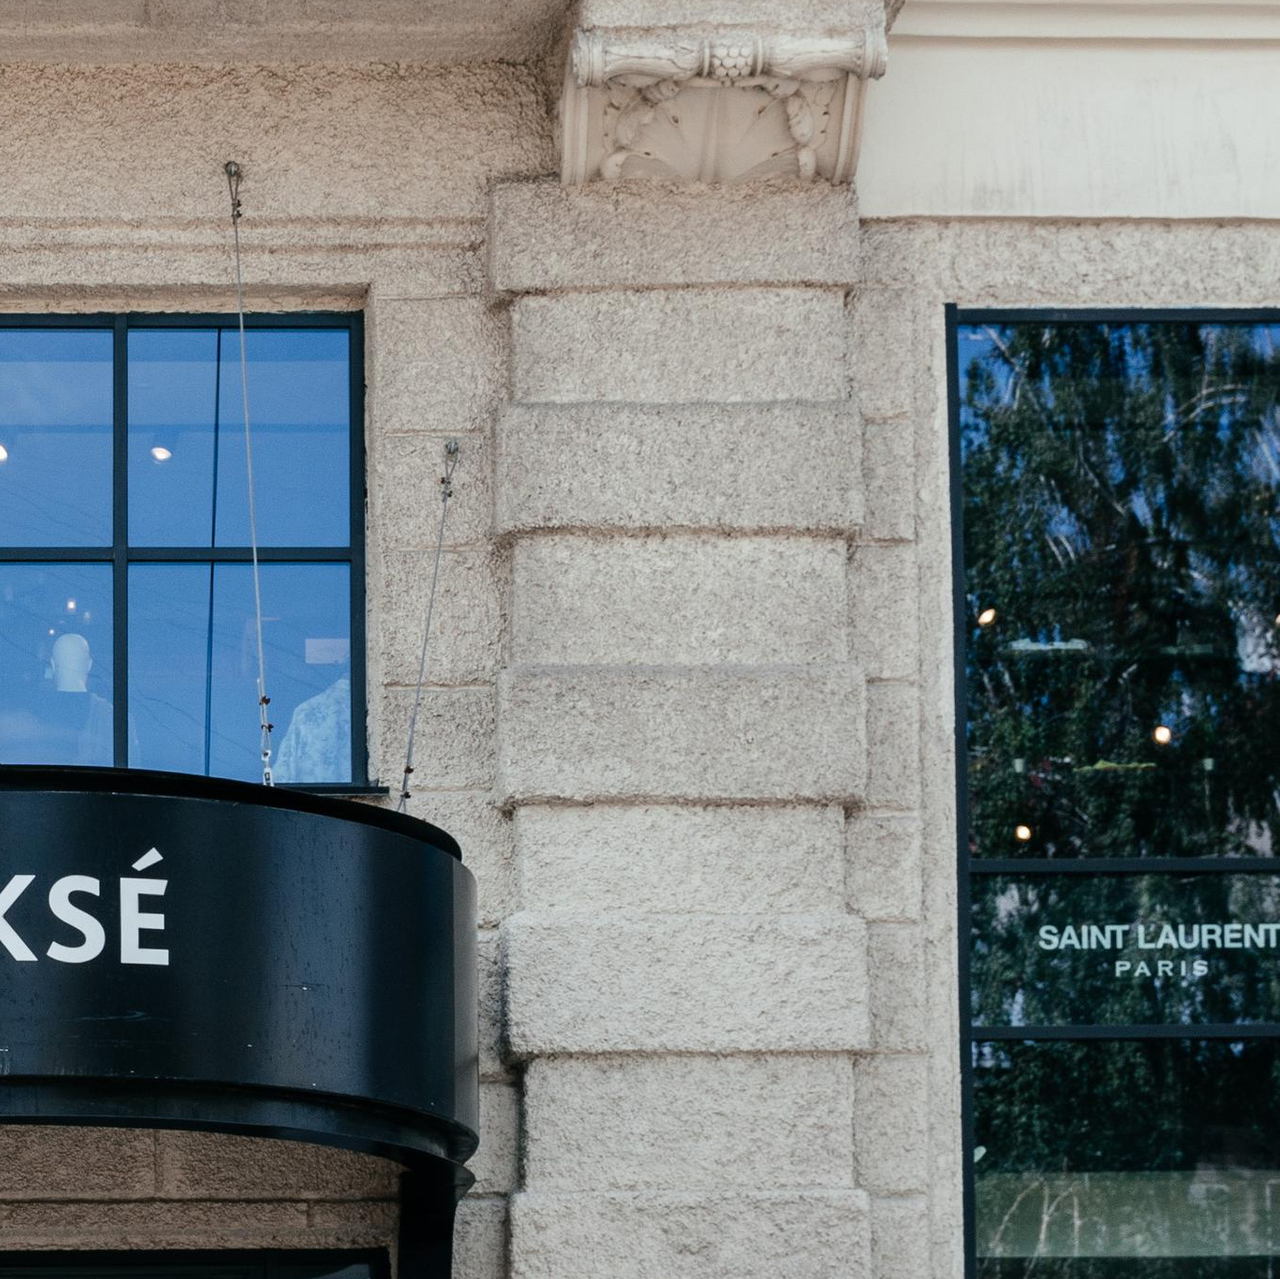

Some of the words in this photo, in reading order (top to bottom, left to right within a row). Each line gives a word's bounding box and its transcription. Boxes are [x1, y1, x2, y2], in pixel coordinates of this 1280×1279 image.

[1038, 925, 1129, 950] SAINT
[1138, 923, 1280, 950] LAURENT
[1115, 960, 1209, 977] PARIS
